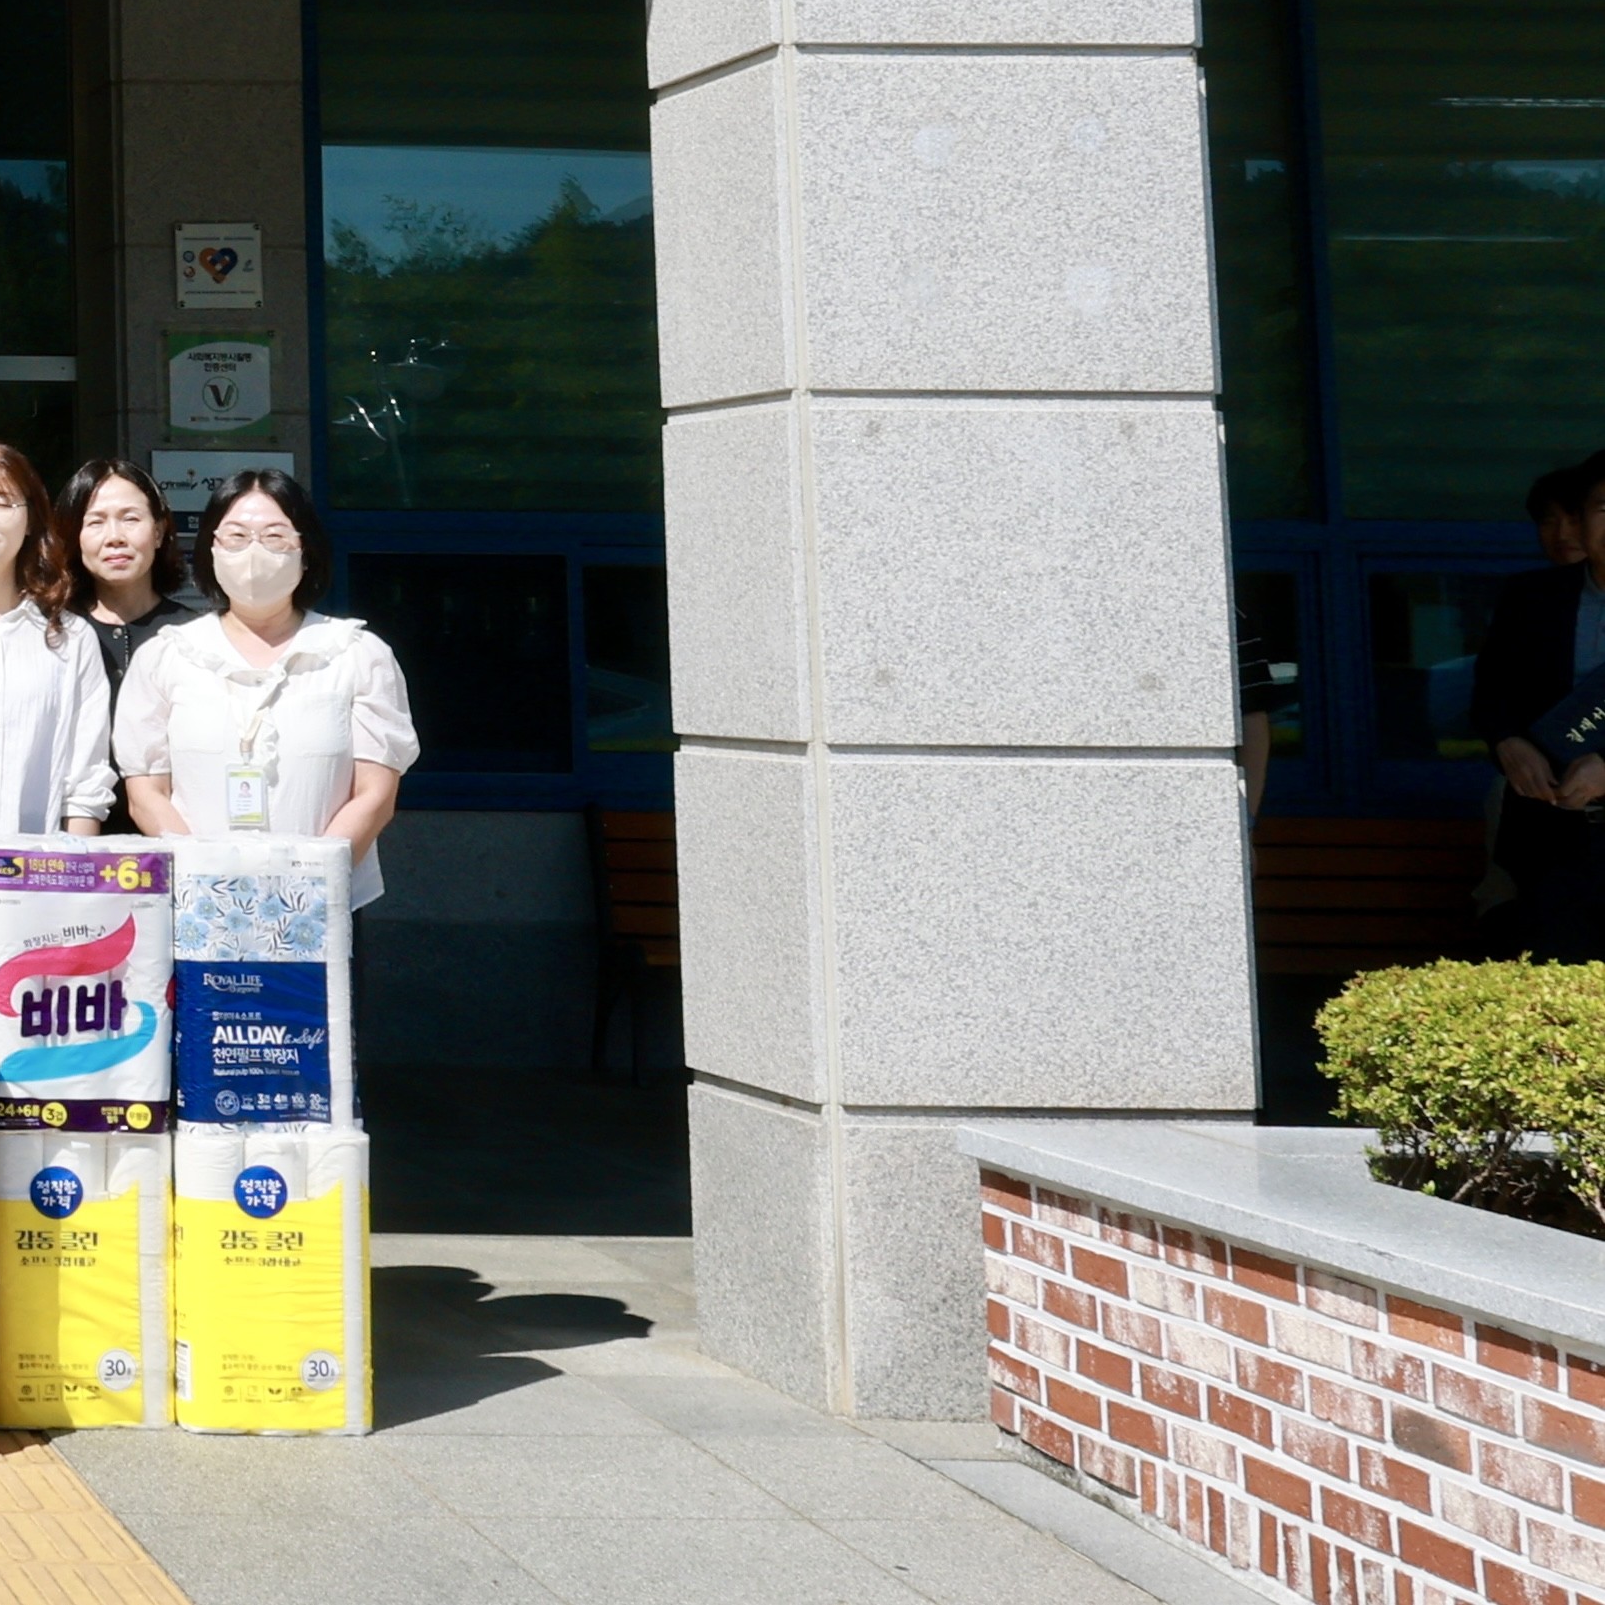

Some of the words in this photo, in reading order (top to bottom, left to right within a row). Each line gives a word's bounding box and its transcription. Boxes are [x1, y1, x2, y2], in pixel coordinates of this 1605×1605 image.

[23, 932, 60, 948] 화장지는
[21, 979, 128, 1037] 비바
[212, 1047, 262, 1064] 천연펄프
[262, 1047, 300, 1064] 화장지
[35, 1178, 77, 1196] 정직한
[239, 1177, 282, 1195] 정직한
[41, 1194, 71, 1210] 가격
[245, 1194, 277, 1210] 가격
[14, 1230, 54, 1251] 감동
[60, 1230, 98, 1252] 클린
[217, 1229, 259, 1251] 감동
[264, 1230, 304, 1252] 클린
